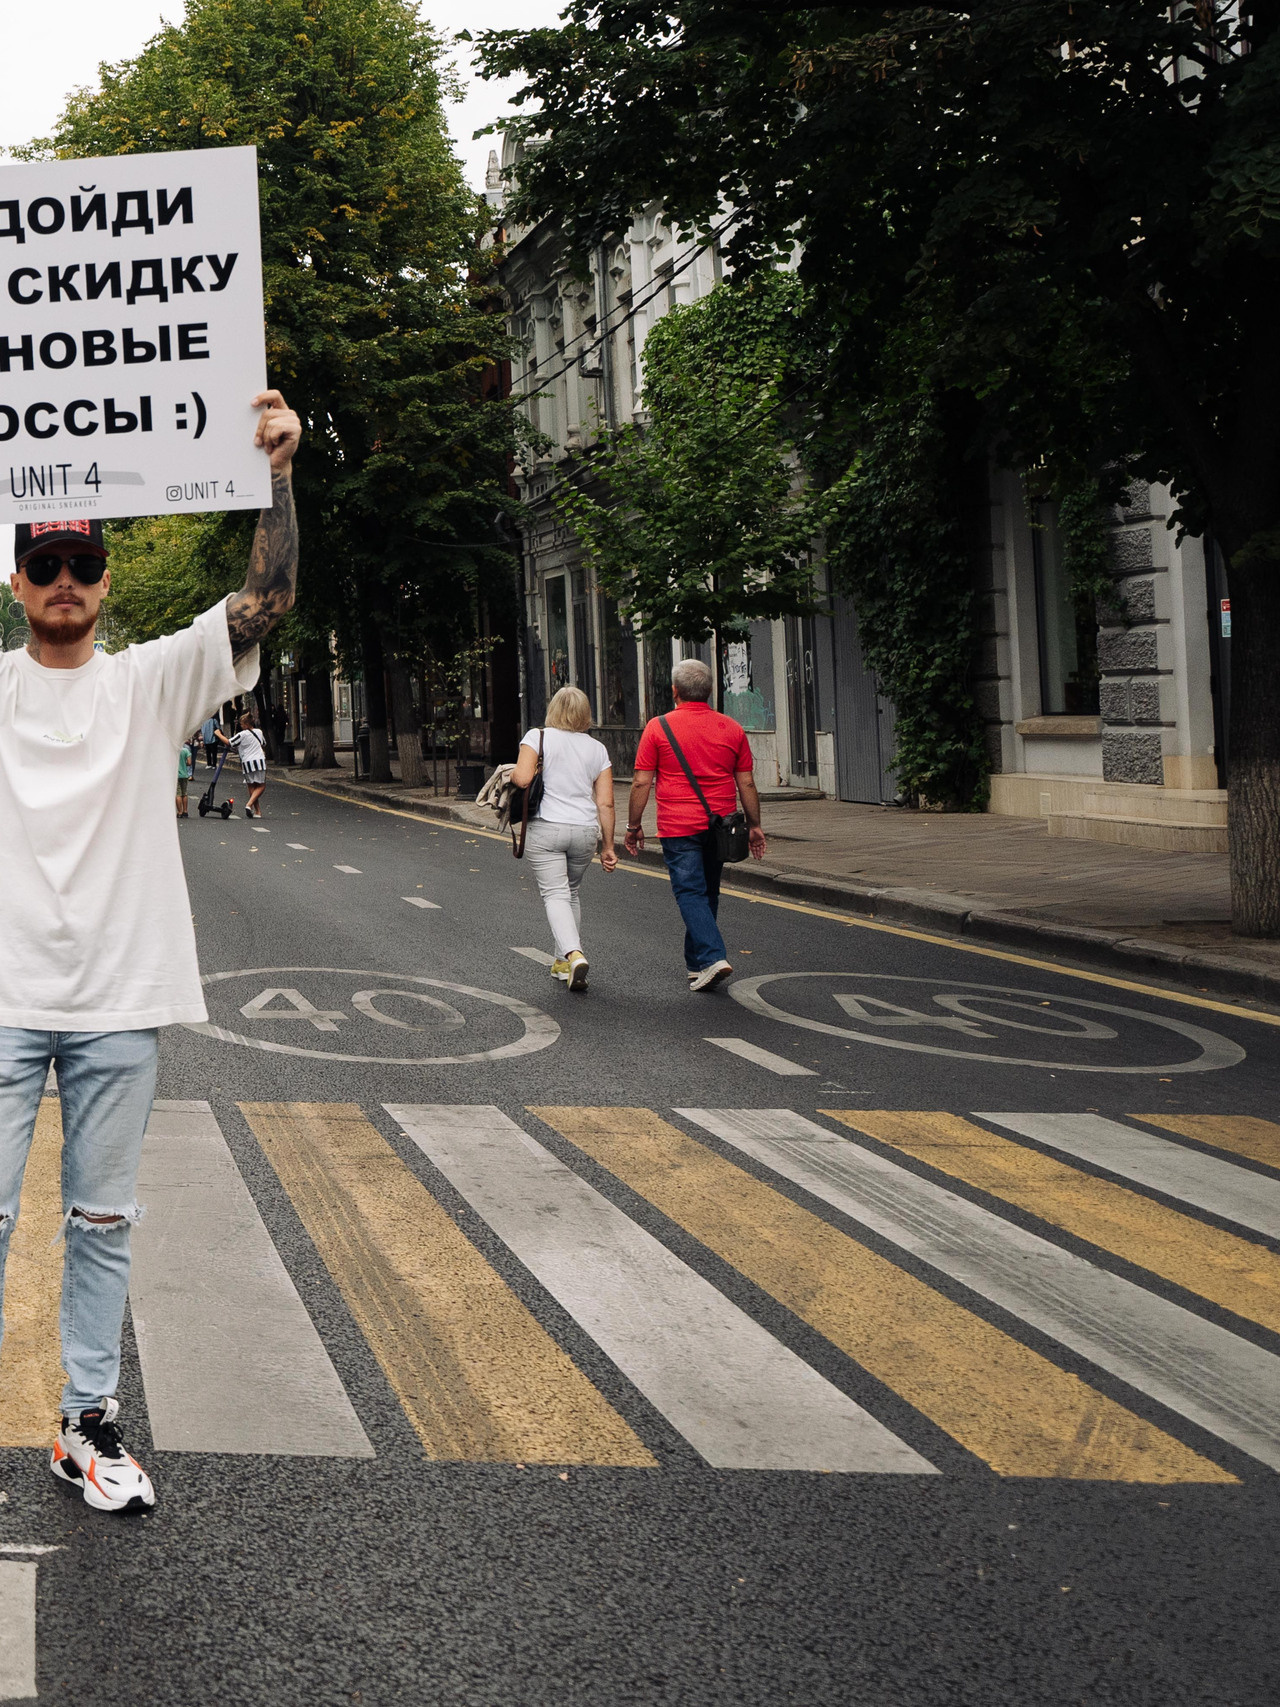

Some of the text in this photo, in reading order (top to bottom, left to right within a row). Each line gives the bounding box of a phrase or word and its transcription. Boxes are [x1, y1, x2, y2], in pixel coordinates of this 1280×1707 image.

[7, 252, 239, 306] СКИДКУ
[10, 461, 102, 499] UNIT 4
[184, 480, 219, 501] UNIT
[18, 499, 98, 512] ORIGINAL SNEAKERS
[239, 988, 466, 1032] 40
[831, 994, 1119, 1039] 40
